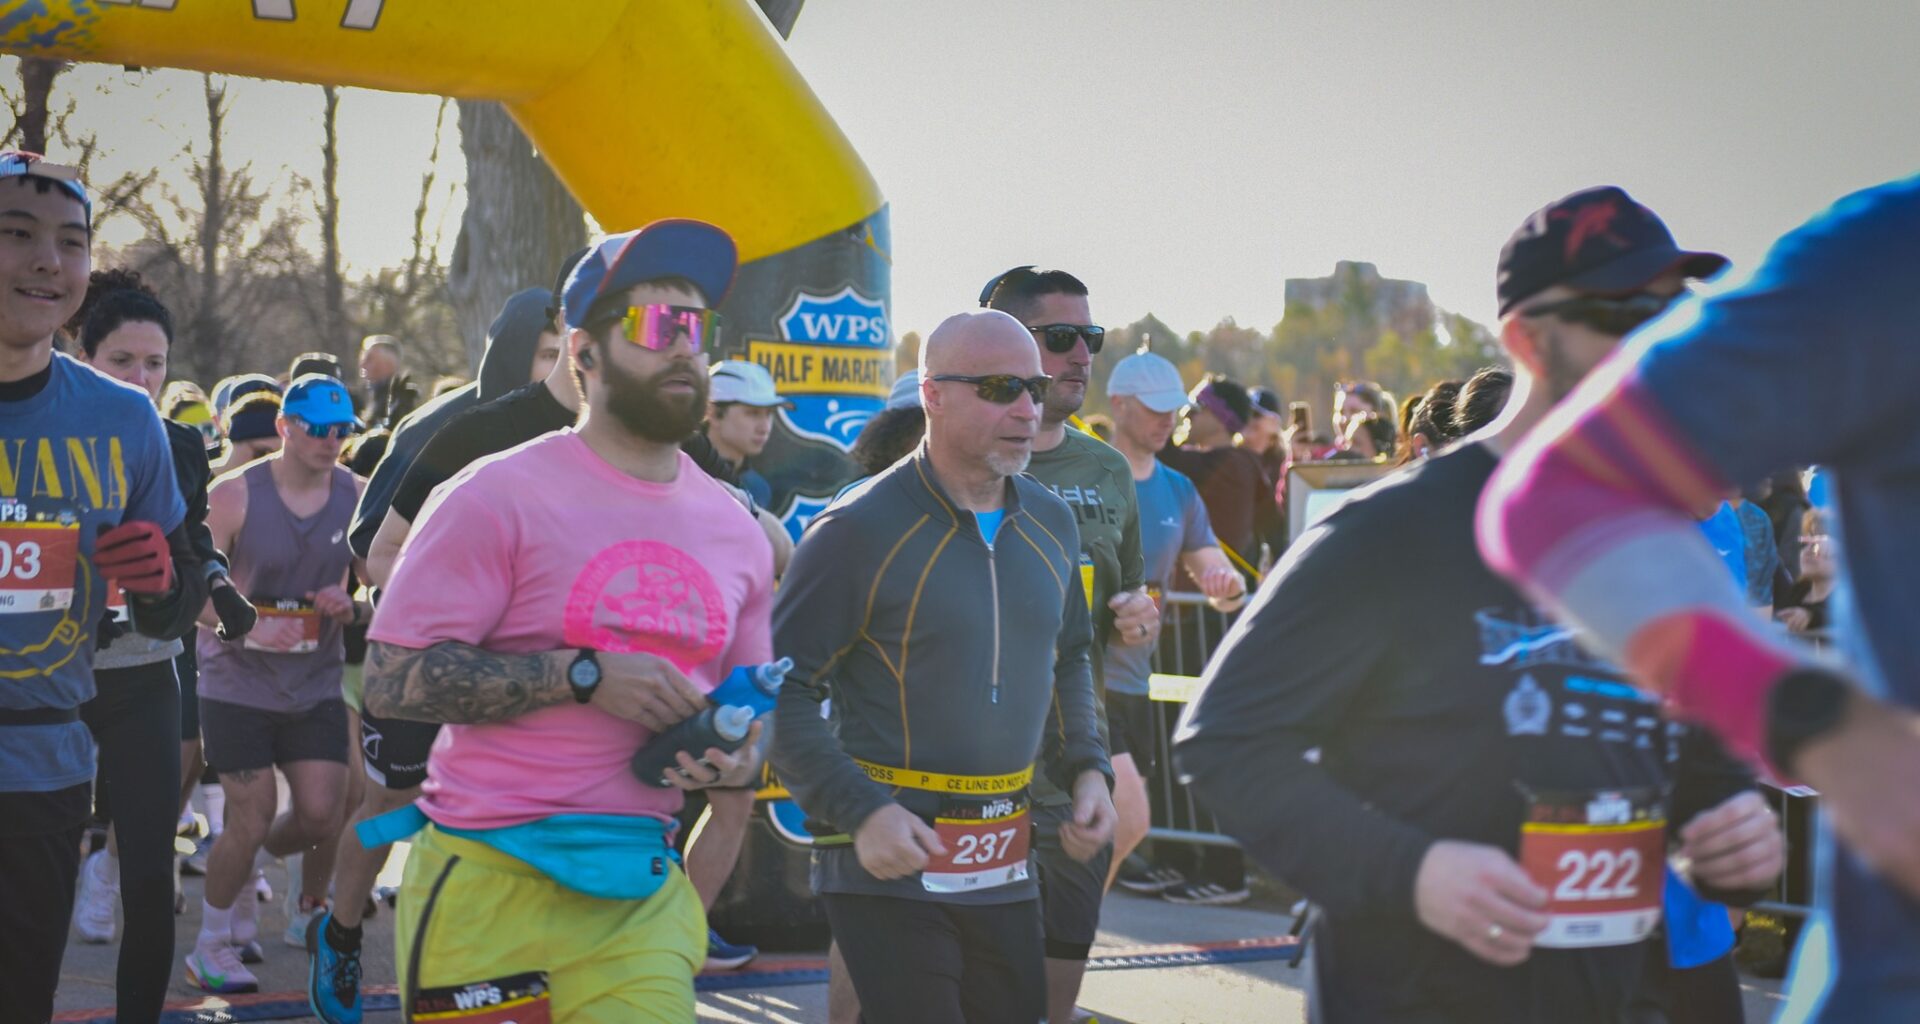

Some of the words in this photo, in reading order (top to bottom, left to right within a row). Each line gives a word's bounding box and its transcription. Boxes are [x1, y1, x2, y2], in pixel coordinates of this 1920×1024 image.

[799, 312, 884, 344] WPS
[757, 352, 814, 383] HALF
[0, 436, 128, 509] VANA
[0, 503, 28, 522] PS
[856, 763, 894, 782] ROSS
[965, 779, 990, 791] LINE
[991, 777, 1005, 791] DO
[982, 801, 1014, 820] WPS
[952, 828, 1017, 866] 237
[1554, 848, 1642, 901] 222
[453, 986, 502, 1011] WPS
